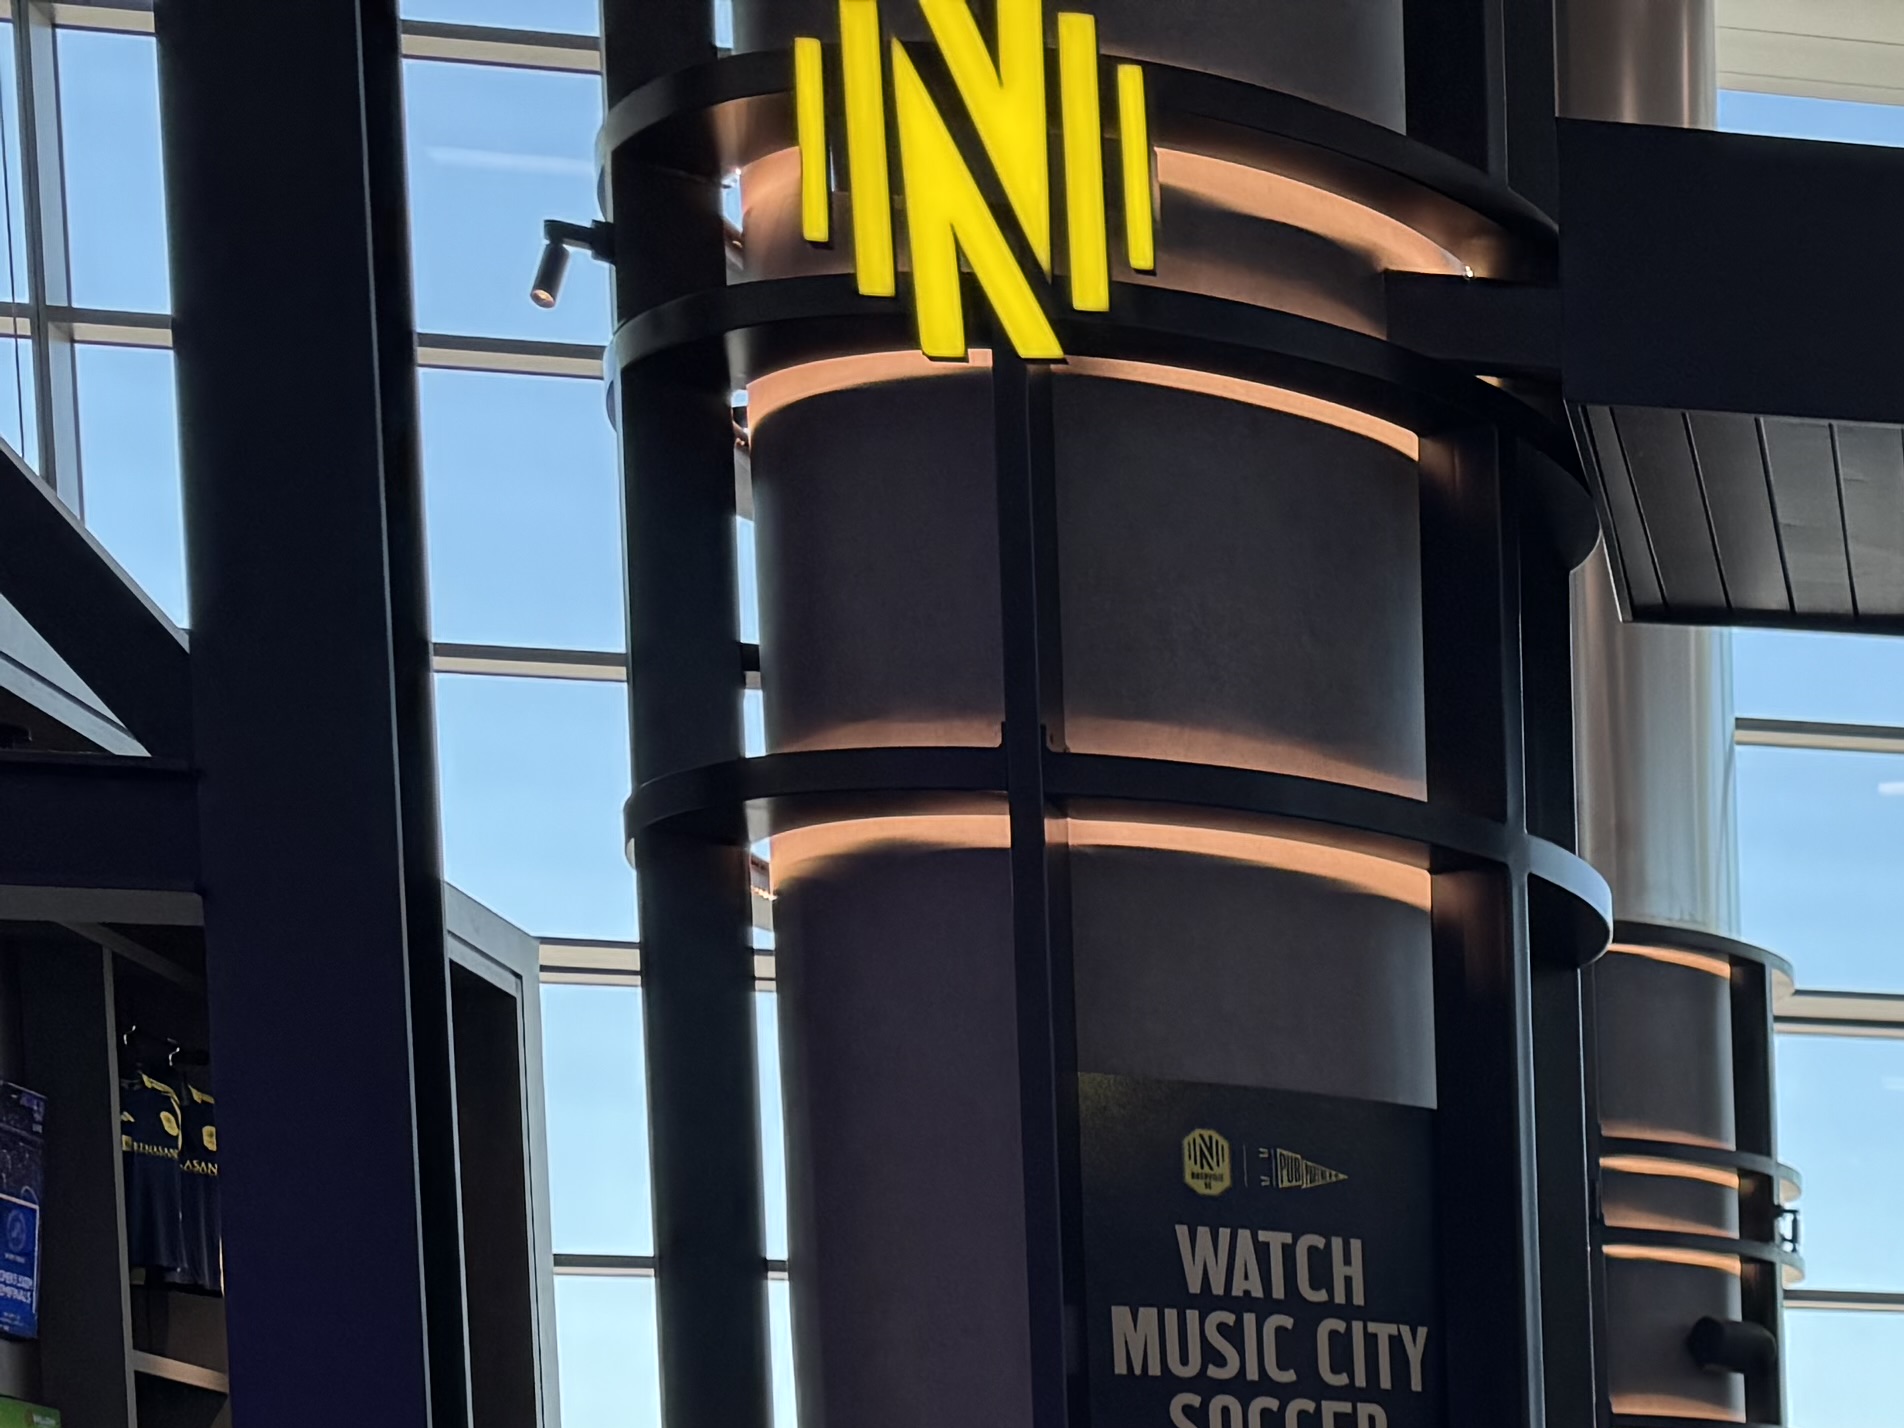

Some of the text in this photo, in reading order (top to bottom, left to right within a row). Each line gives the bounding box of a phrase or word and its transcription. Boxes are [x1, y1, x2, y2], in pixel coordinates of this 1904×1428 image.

[1278, 1150, 1301, 1185] PUB
[1174, 1223, 1365, 1307] WATCH
[1110, 1304, 1429, 1392] MUSIC CITY
